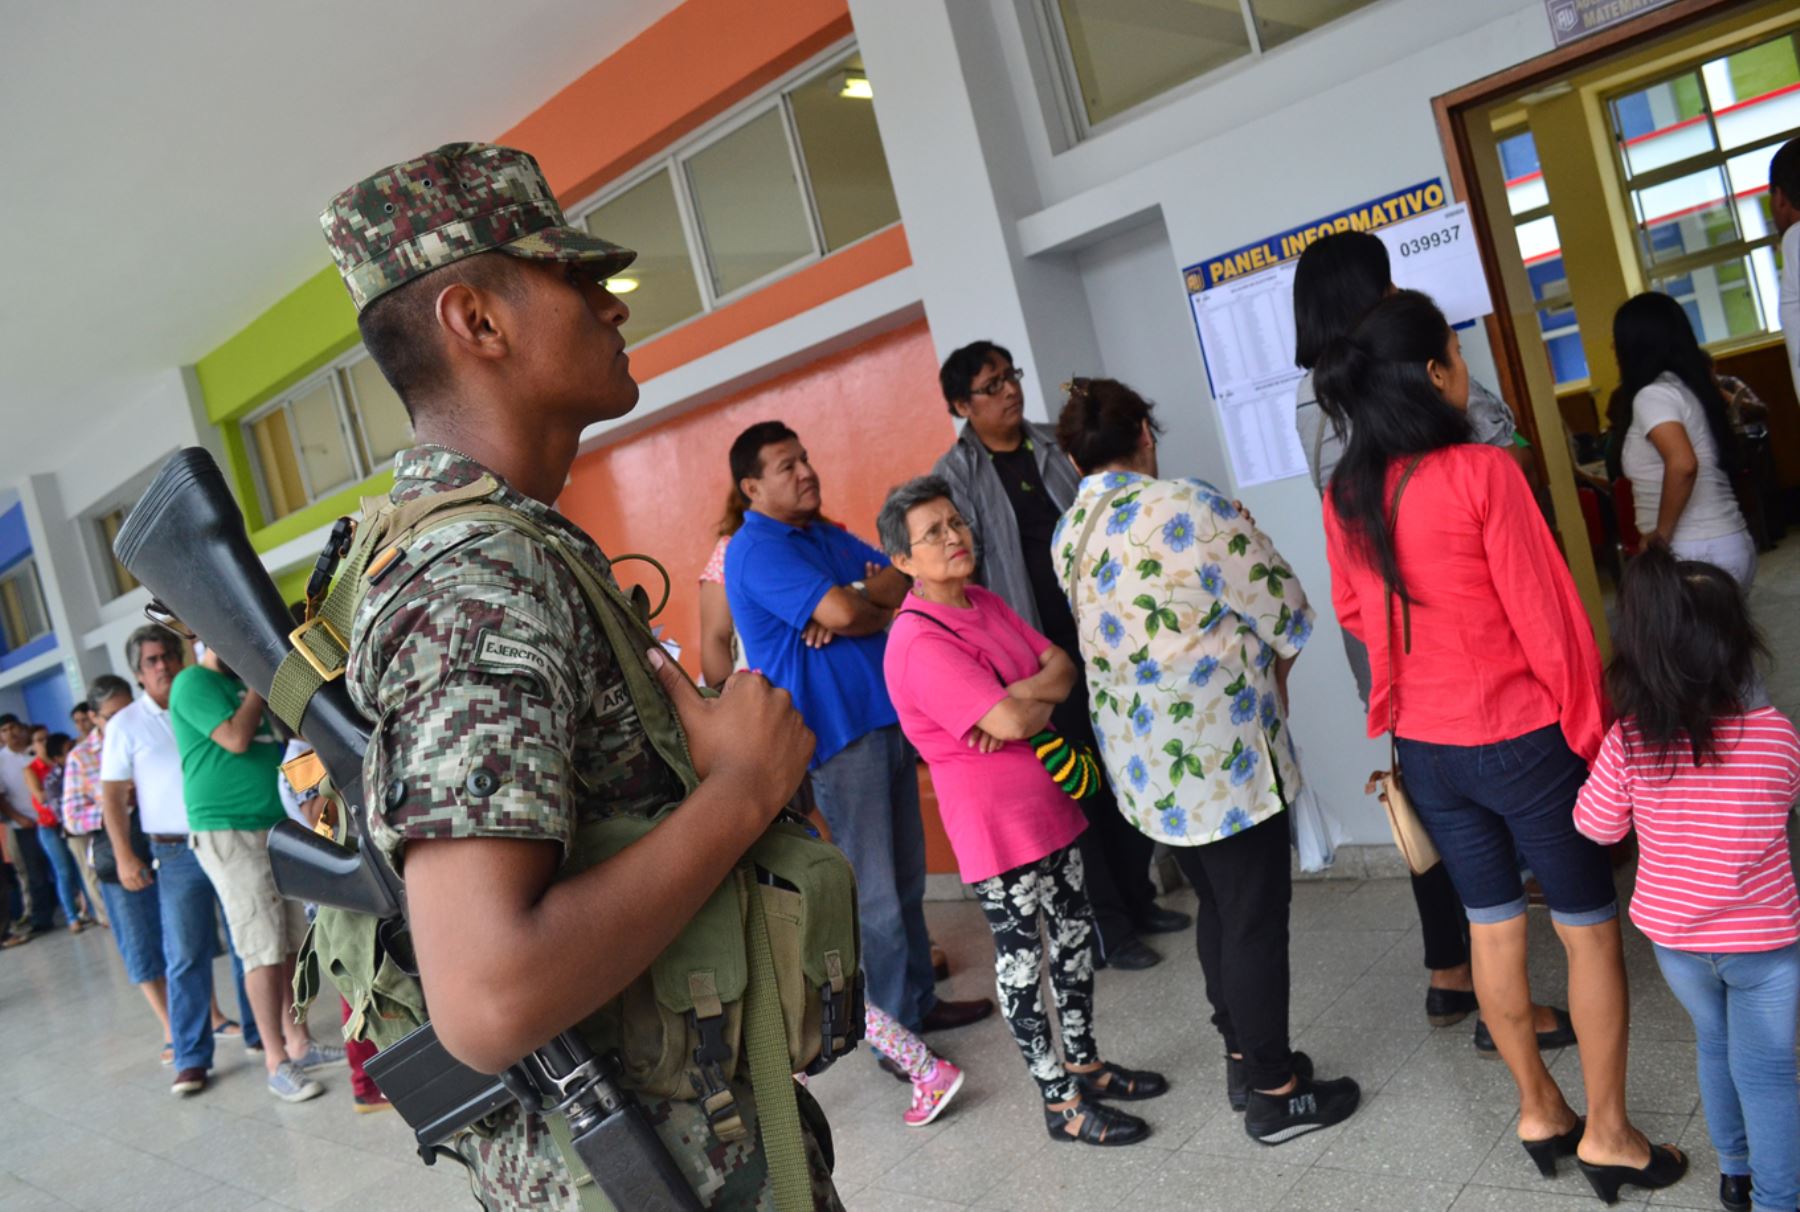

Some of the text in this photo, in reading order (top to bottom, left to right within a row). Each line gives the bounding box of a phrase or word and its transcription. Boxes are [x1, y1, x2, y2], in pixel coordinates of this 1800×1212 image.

[1210, 184, 1444, 283] PANEL INFORMATIVO
[1400, 224, 1460, 257] 039937
[486, 642, 545, 667] EJERCITO
[603, 688, 628, 711] AR
